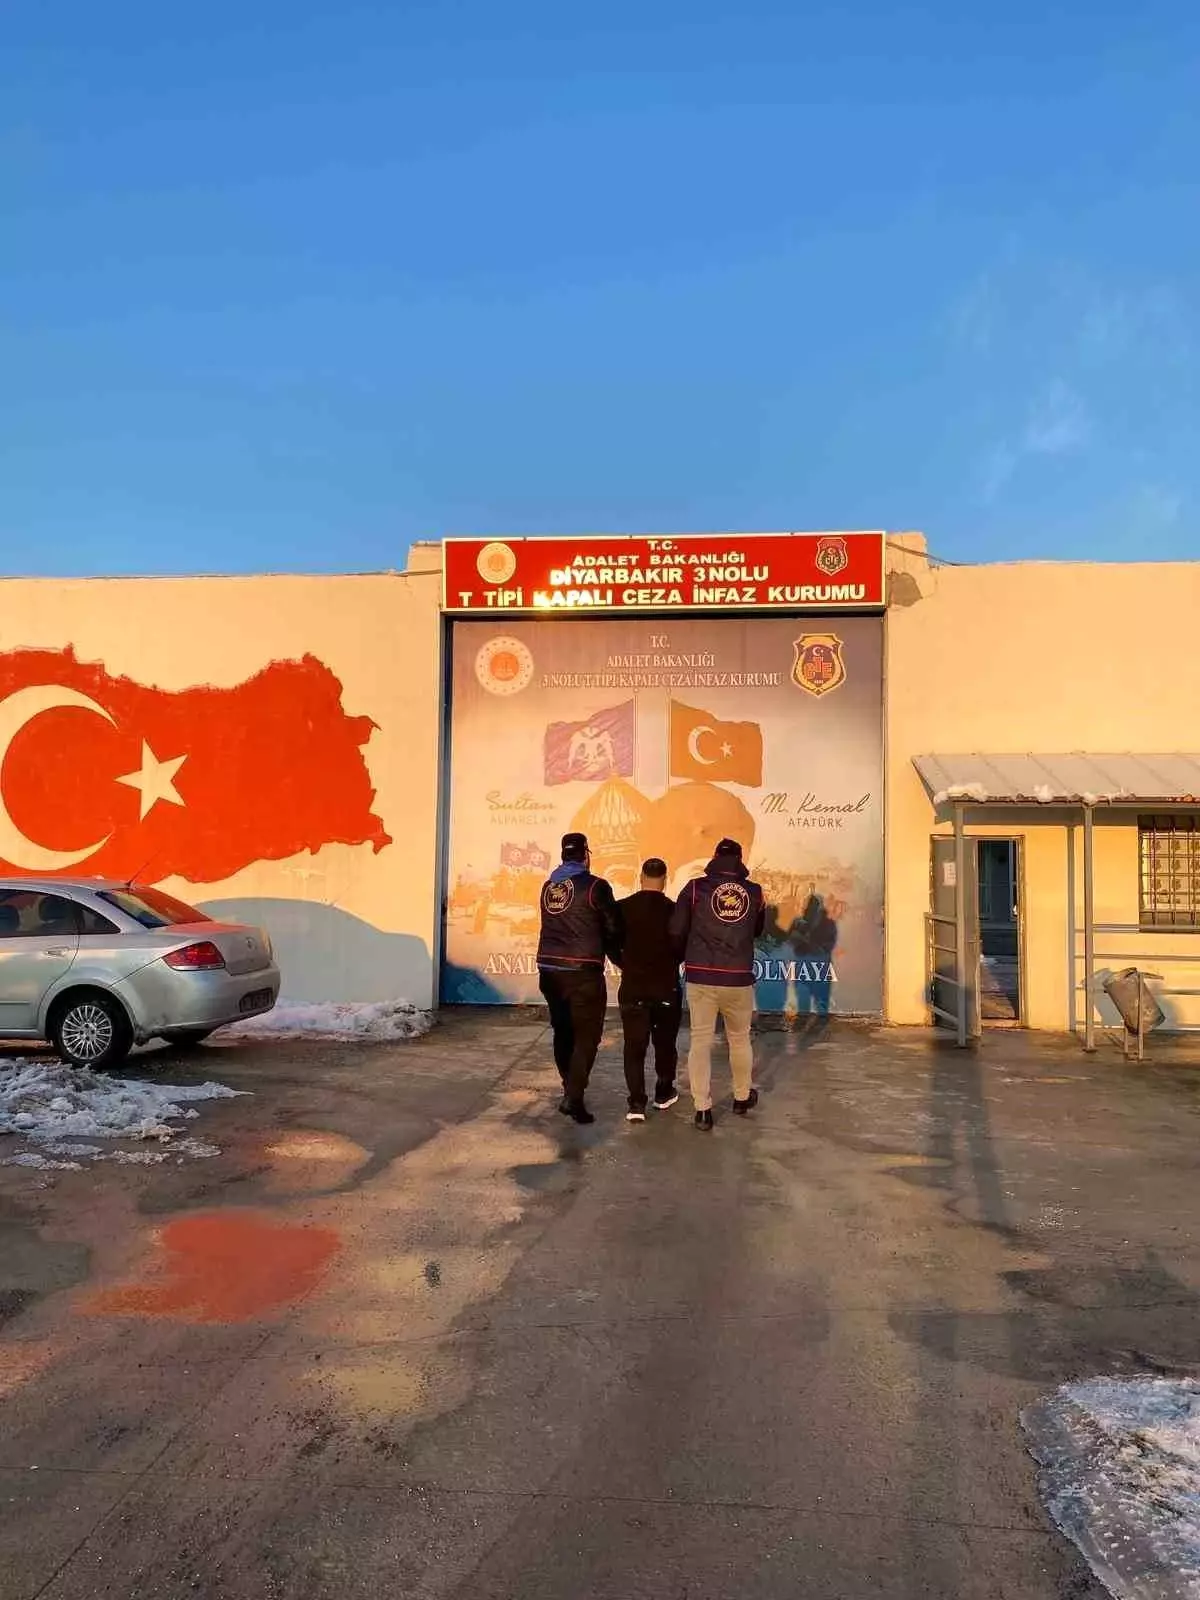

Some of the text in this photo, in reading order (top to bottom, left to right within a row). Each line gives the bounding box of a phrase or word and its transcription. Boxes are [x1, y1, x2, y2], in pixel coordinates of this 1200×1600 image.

[647, 540, 678, 551] T.C.
[573, 551, 745, 567] ADALET BAKANLIĞI
[549, 566, 683, 586] DİYARBAKIR
[458, 584, 866, 607] T TİPİ KAPALI CEZA İNFAZ KURUMU
[649, 635, 671, 649] T.C.
[606, 650, 716, 668] ADALET BAKANLIĞI
[619, 673, 660, 687] KAPALI
[661, 673, 692, 687] CEZA
[729, 672, 783, 686] KURUMU
[485, 790, 557, 811] Sultan
[797, 792, 871, 814] Kemal
[788, 816, 843, 829] ATATÜRK
[483, 953, 540, 975] ANAD
